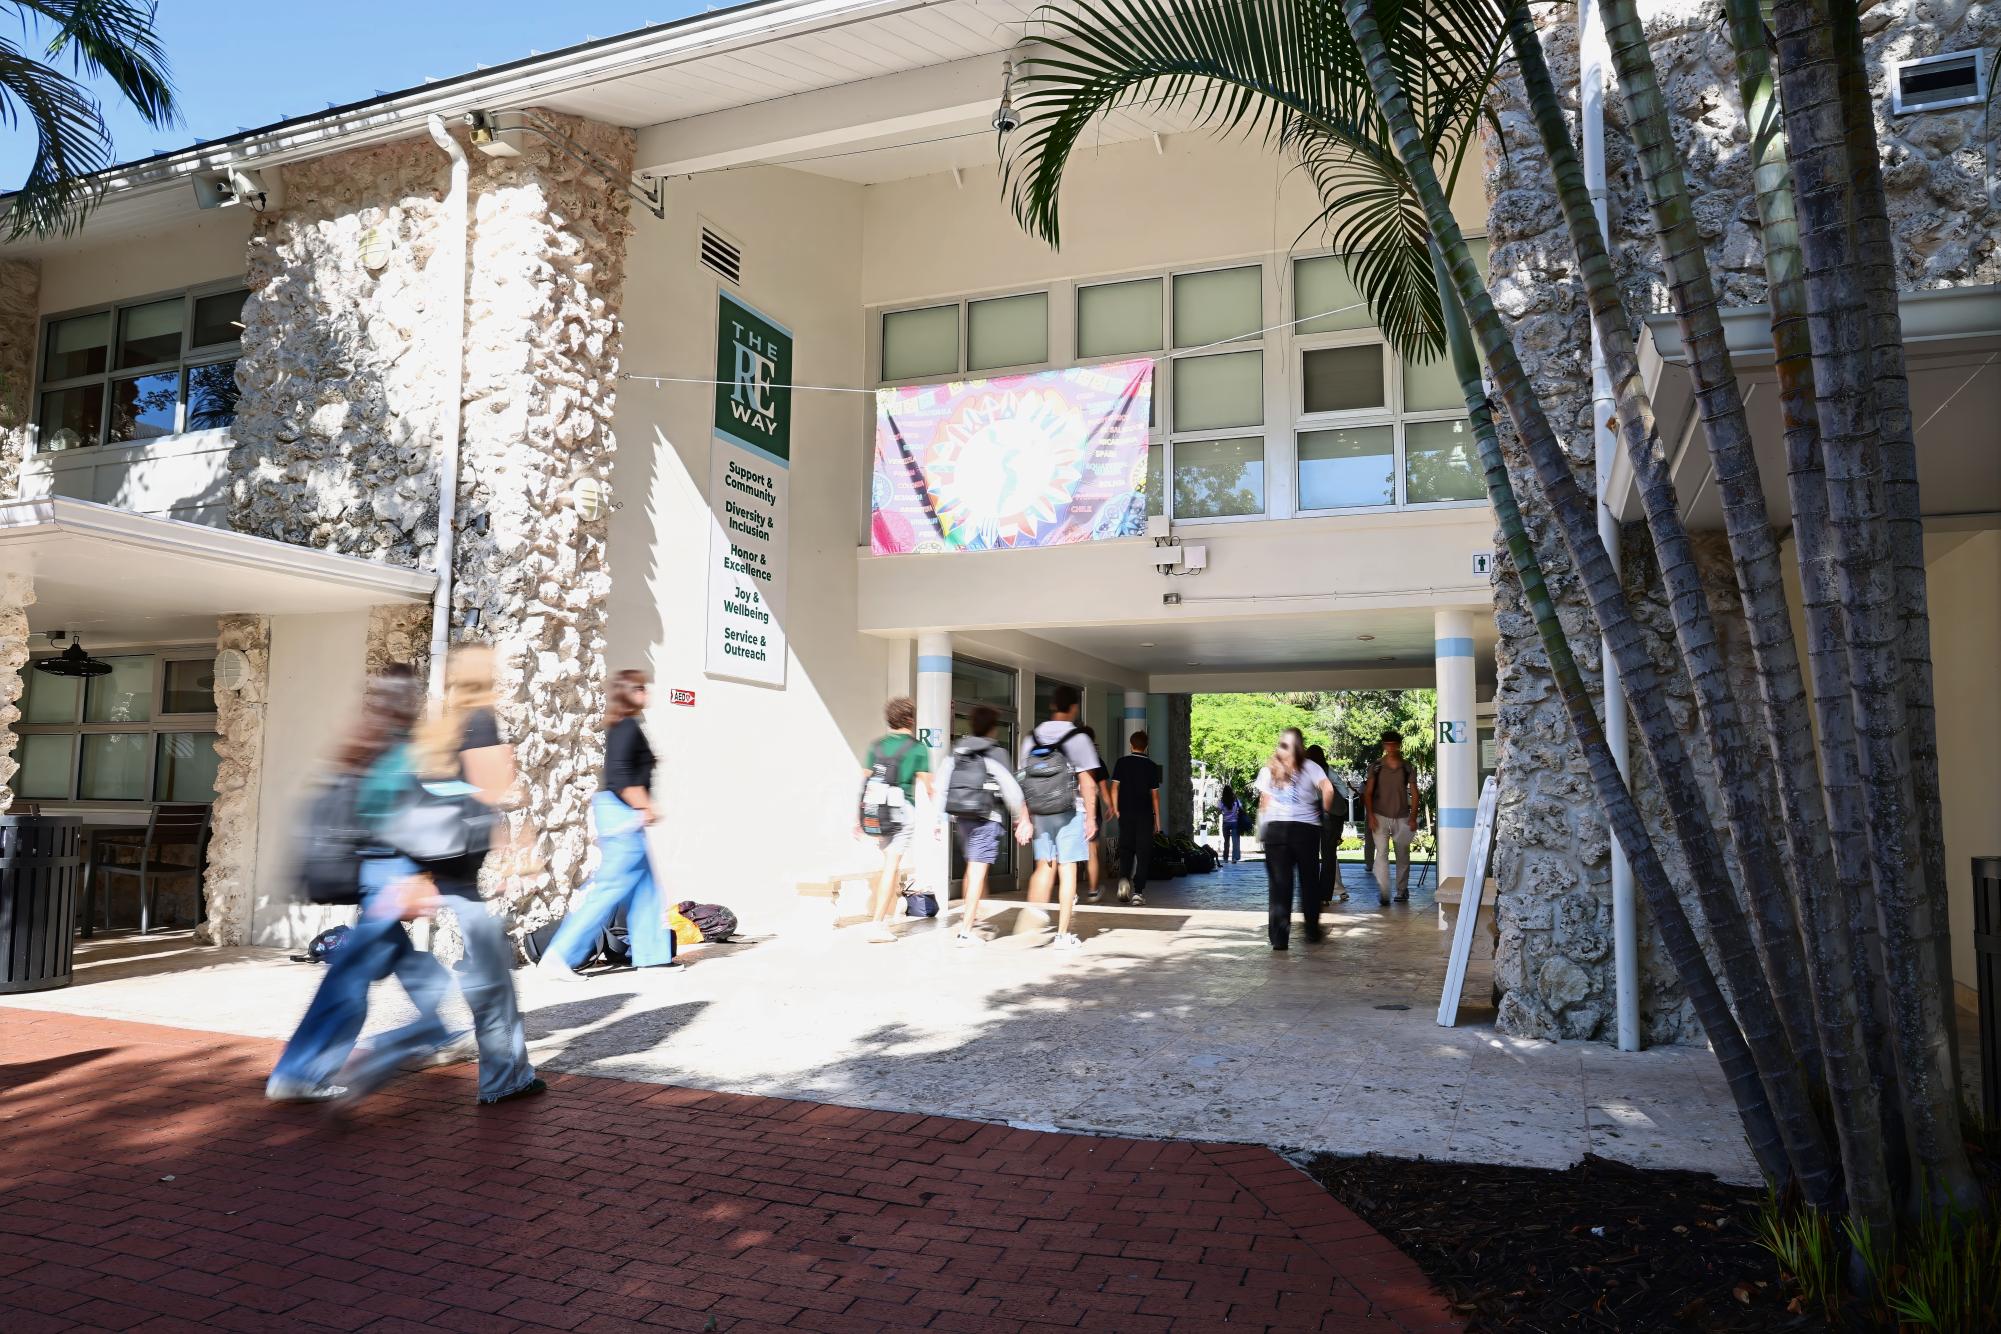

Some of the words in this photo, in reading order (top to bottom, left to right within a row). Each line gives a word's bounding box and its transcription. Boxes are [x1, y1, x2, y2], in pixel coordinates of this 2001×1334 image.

[731, 321, 778, 361] THE
[731, 340, 775, 419] RE
[731, 401, 778, 436] WAY
[729, 461, 765, 487] Support
[766, 477, 773, 489] &
[725, 474, 776, 506] Community
[726, 500, 765, 527] Diversity
[767, 517, 774, 528] &
[729, 516, 769, 541] Inclusion
[731, 543, 758, 562] Honor
[760, 554, 766, 565] &
[724, 556, 772, 581] Excellence
[735, 586, 751, 603] Joy
[753, 592, 759, 603] &
[724, 600, 769, 624] Wellbeing
[724, 627, 758, 645] Service
[760, 636, 766, 647] &
[724, 643, 766, 661] Outreach
[675, 692, 685, 701] AED
[919, 728, 942, 747] RE
[1439, 720, 1467, 743] RE
